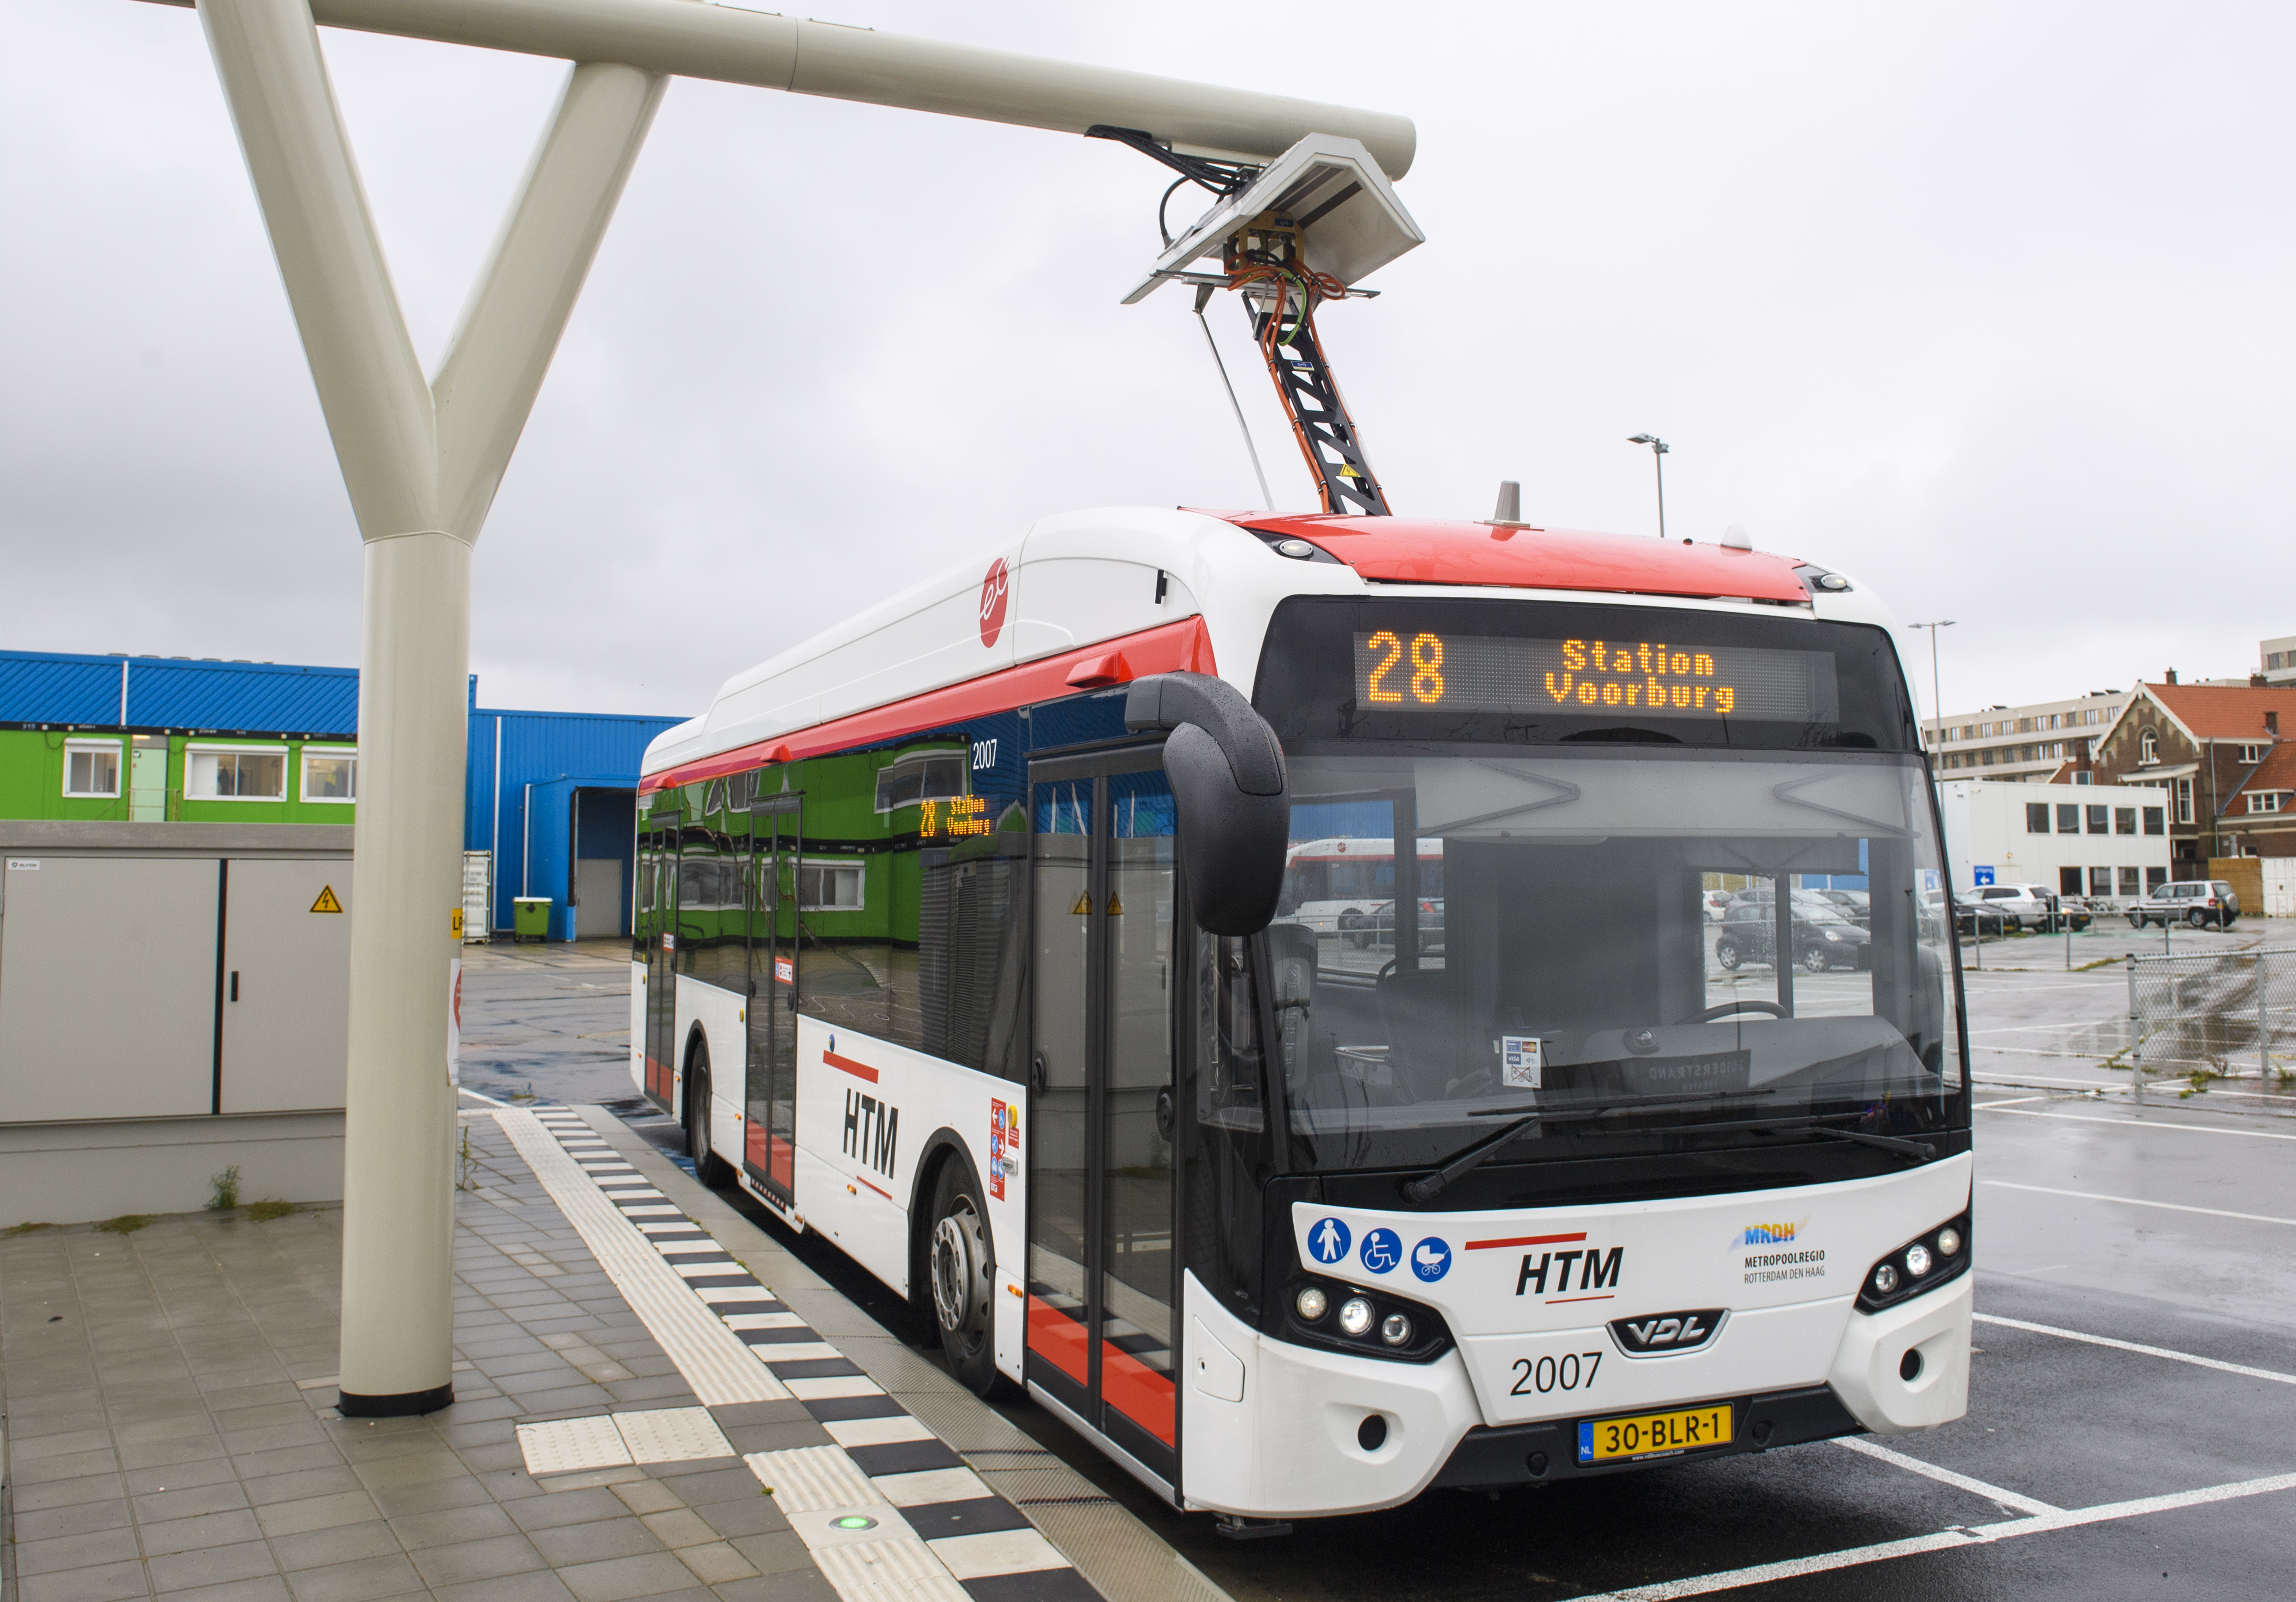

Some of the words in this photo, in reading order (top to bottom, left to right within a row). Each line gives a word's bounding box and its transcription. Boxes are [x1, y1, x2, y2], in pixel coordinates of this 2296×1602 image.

[1368, 631, 1443, 703] 28
[1563, 639, 1714, 676] Station
[1545, 672, 1734, 713] Voorburg
[973, 739, 997, 770] 2007
[921, 799, 936, 837] 28
[950, 794, 985, 815] Station
[947, 816, 990, 836] Voorburg
[843, 1087, 899, 1180] HTM
[1744, 1222, 1795, 1245] MRDH
[1516, 1246, 1624, 1296] HTM
[1744, 1249, 1825, 1269] METROPOOLREGIO
[1744, 1270, 1788, 1284] ROTTERDAM
[1790, 1268, 1804, 1279] DEN
[1805, 1265, 1825, 1278] HAAG
[1627, 1317, 1706, 1344] VDL
[1510, 1351, 1603, 1397] 2007
[1581, 1446, 1592, 1454] NL
[1606, 1412, 1718, 1452] 30-BLR-1
[1632, 1450, 1685, 1461] www.vdlbuscoach.com
